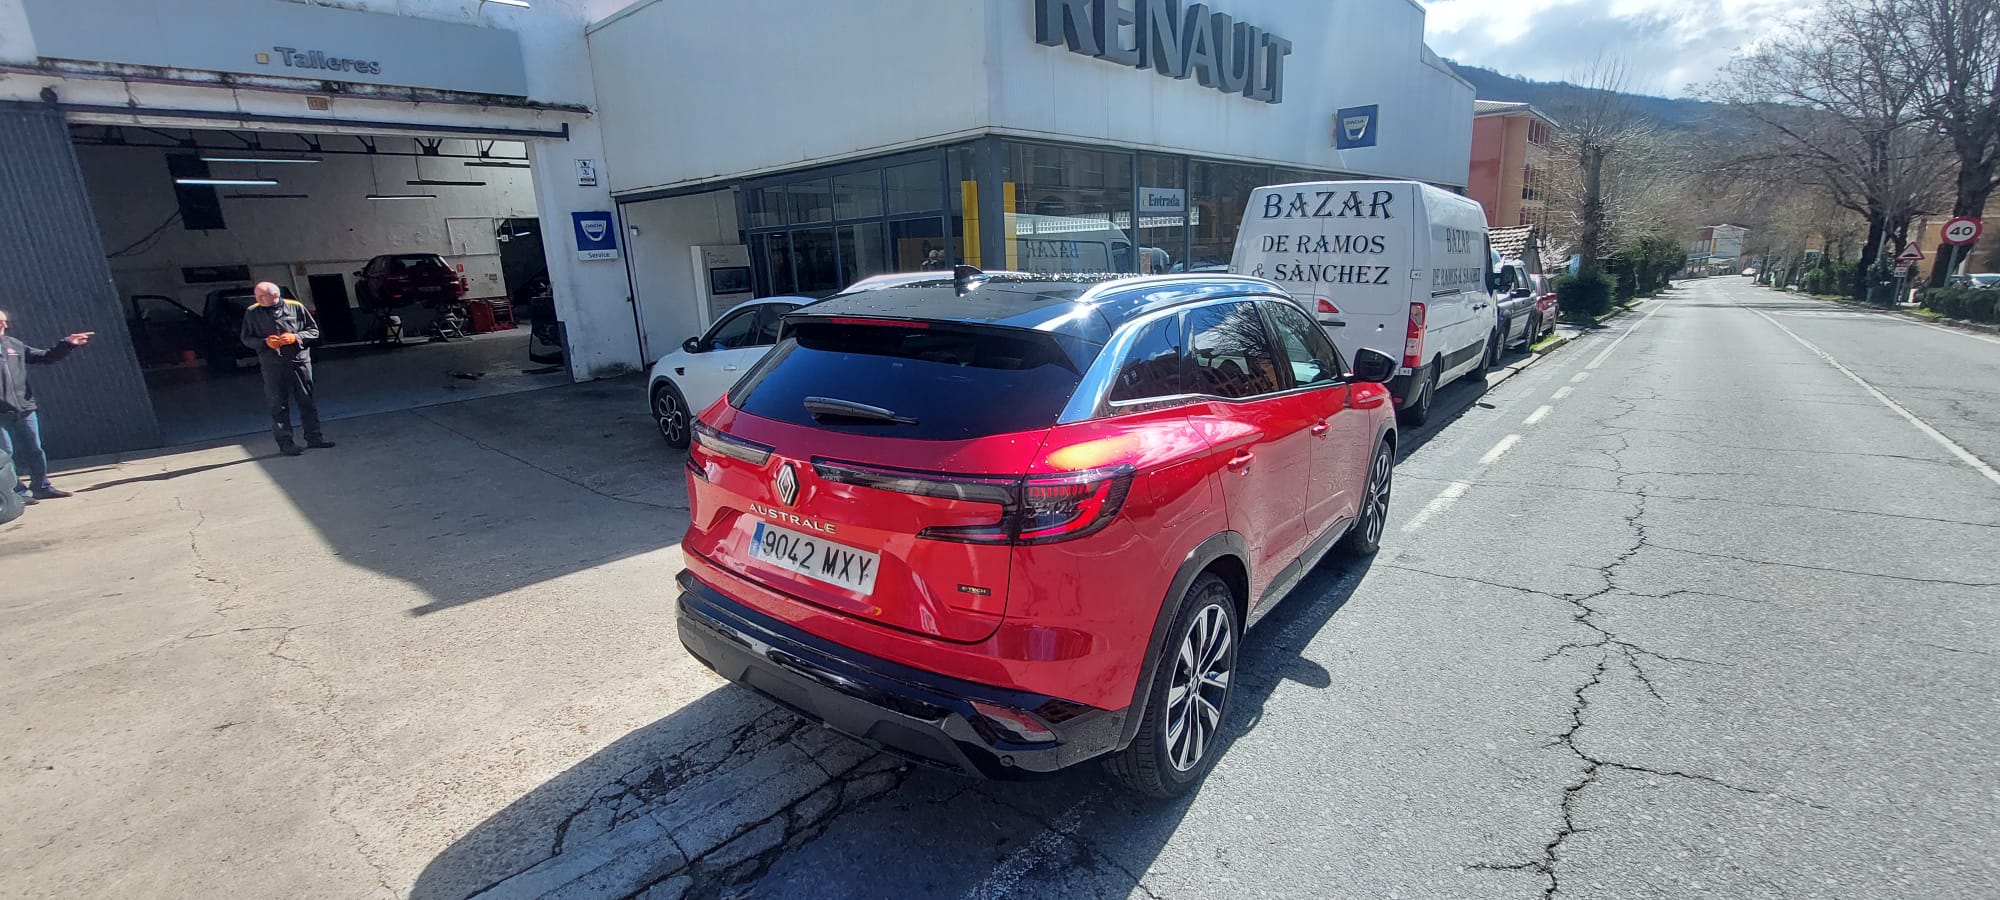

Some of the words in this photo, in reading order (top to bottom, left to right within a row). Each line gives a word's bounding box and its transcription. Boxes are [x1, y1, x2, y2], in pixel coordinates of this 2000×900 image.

[273, 46, 381, 75] Talleres
[1148, 193, 1180, 208] Entrada
[1262, 190, 1395, 220] BAZAR
[1262, 235, 1290, 253] DE
[1296, 234, 1385, 255] RAMOS
[1446, 227, 1471, 255] BAZAR
[1949, 226, 1973, 236] 40
[1274, 260, 1391, 286] SÀNCHEZ
[762, 530, 815, 570] 9042
[821, 546, 872, 586] MXY
